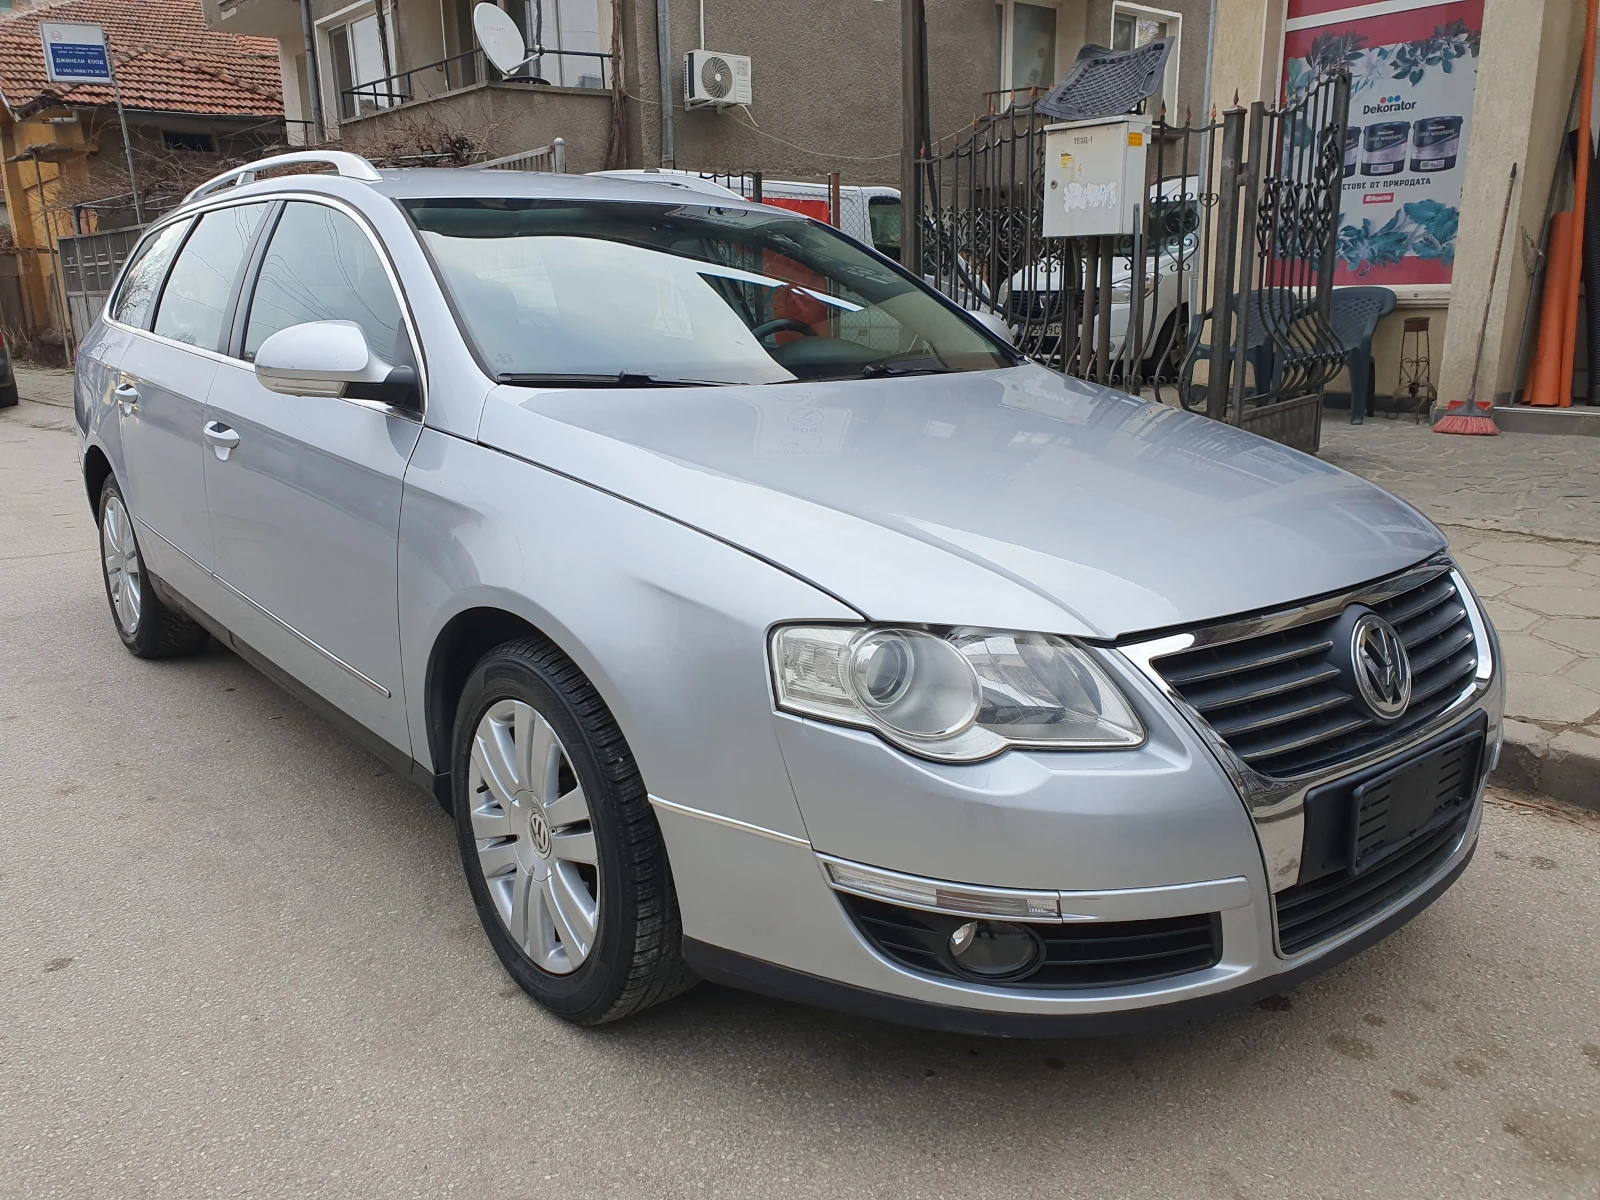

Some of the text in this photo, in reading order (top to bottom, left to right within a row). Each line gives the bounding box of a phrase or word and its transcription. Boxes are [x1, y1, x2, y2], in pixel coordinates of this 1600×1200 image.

[1363, 101, 1417, 115] Dekorator
[1342, 177, 1431, 190] ЕТОВЕ ОТ ПРИРОДАТА
[1354, 617, 1410, 716] VW
[529, 811, 551, 855] VW
